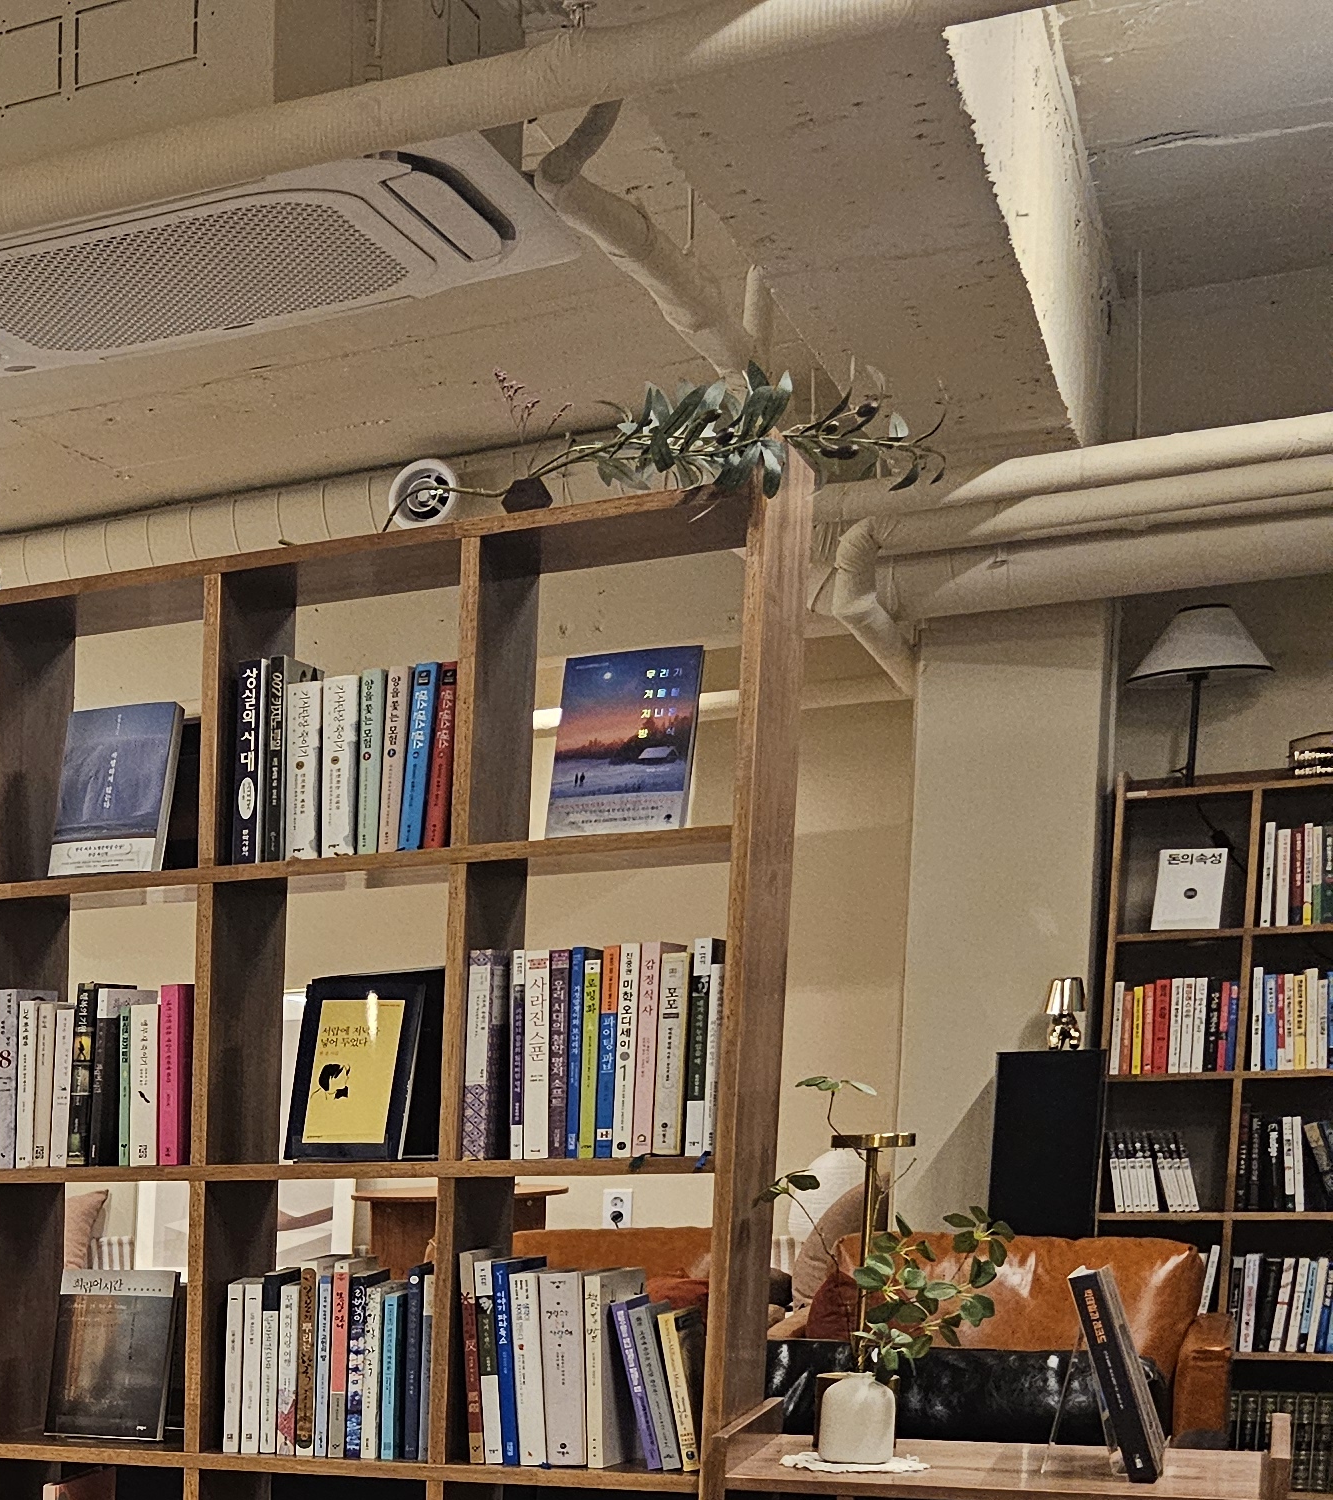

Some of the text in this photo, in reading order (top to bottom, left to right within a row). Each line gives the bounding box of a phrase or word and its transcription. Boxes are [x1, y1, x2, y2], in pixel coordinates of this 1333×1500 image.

[241, 668, 258, 728] 상실의
[271, 672, 282, 695] 007
[297, 690, 311, 758] 기사단장 죽이기
[333, 685, 346, 753] 기사단장 죽이기
[362, 679, 375, 749] 양을 쫓는 모험
[388, 676, 401, 746] 양을 쫓는 모험
[411, 690, 428, 749] 댄스댄스댄스
[437, 690, 454, 749] 댄스댄스댄스
[240, 730, 255, 772] 시대
[78, 993, 89, 1019] 행복의
[622, 979, 634, 1002] 미학
[664, 988, 679, 1010] 모모
[322, 1026, 350, 1036] 서랍에
[528, 976, 546, 1062] 사라진 스푼
[620, 1004, 632, 1050] 오디세이
[140, 1044, 149, 1066] 죽이기
[619, 1065, 626, 1081] 1
[284, 1332, 292, 1349] 사랑
[496, 1290, 508, 1345] 이야기 파라독스
